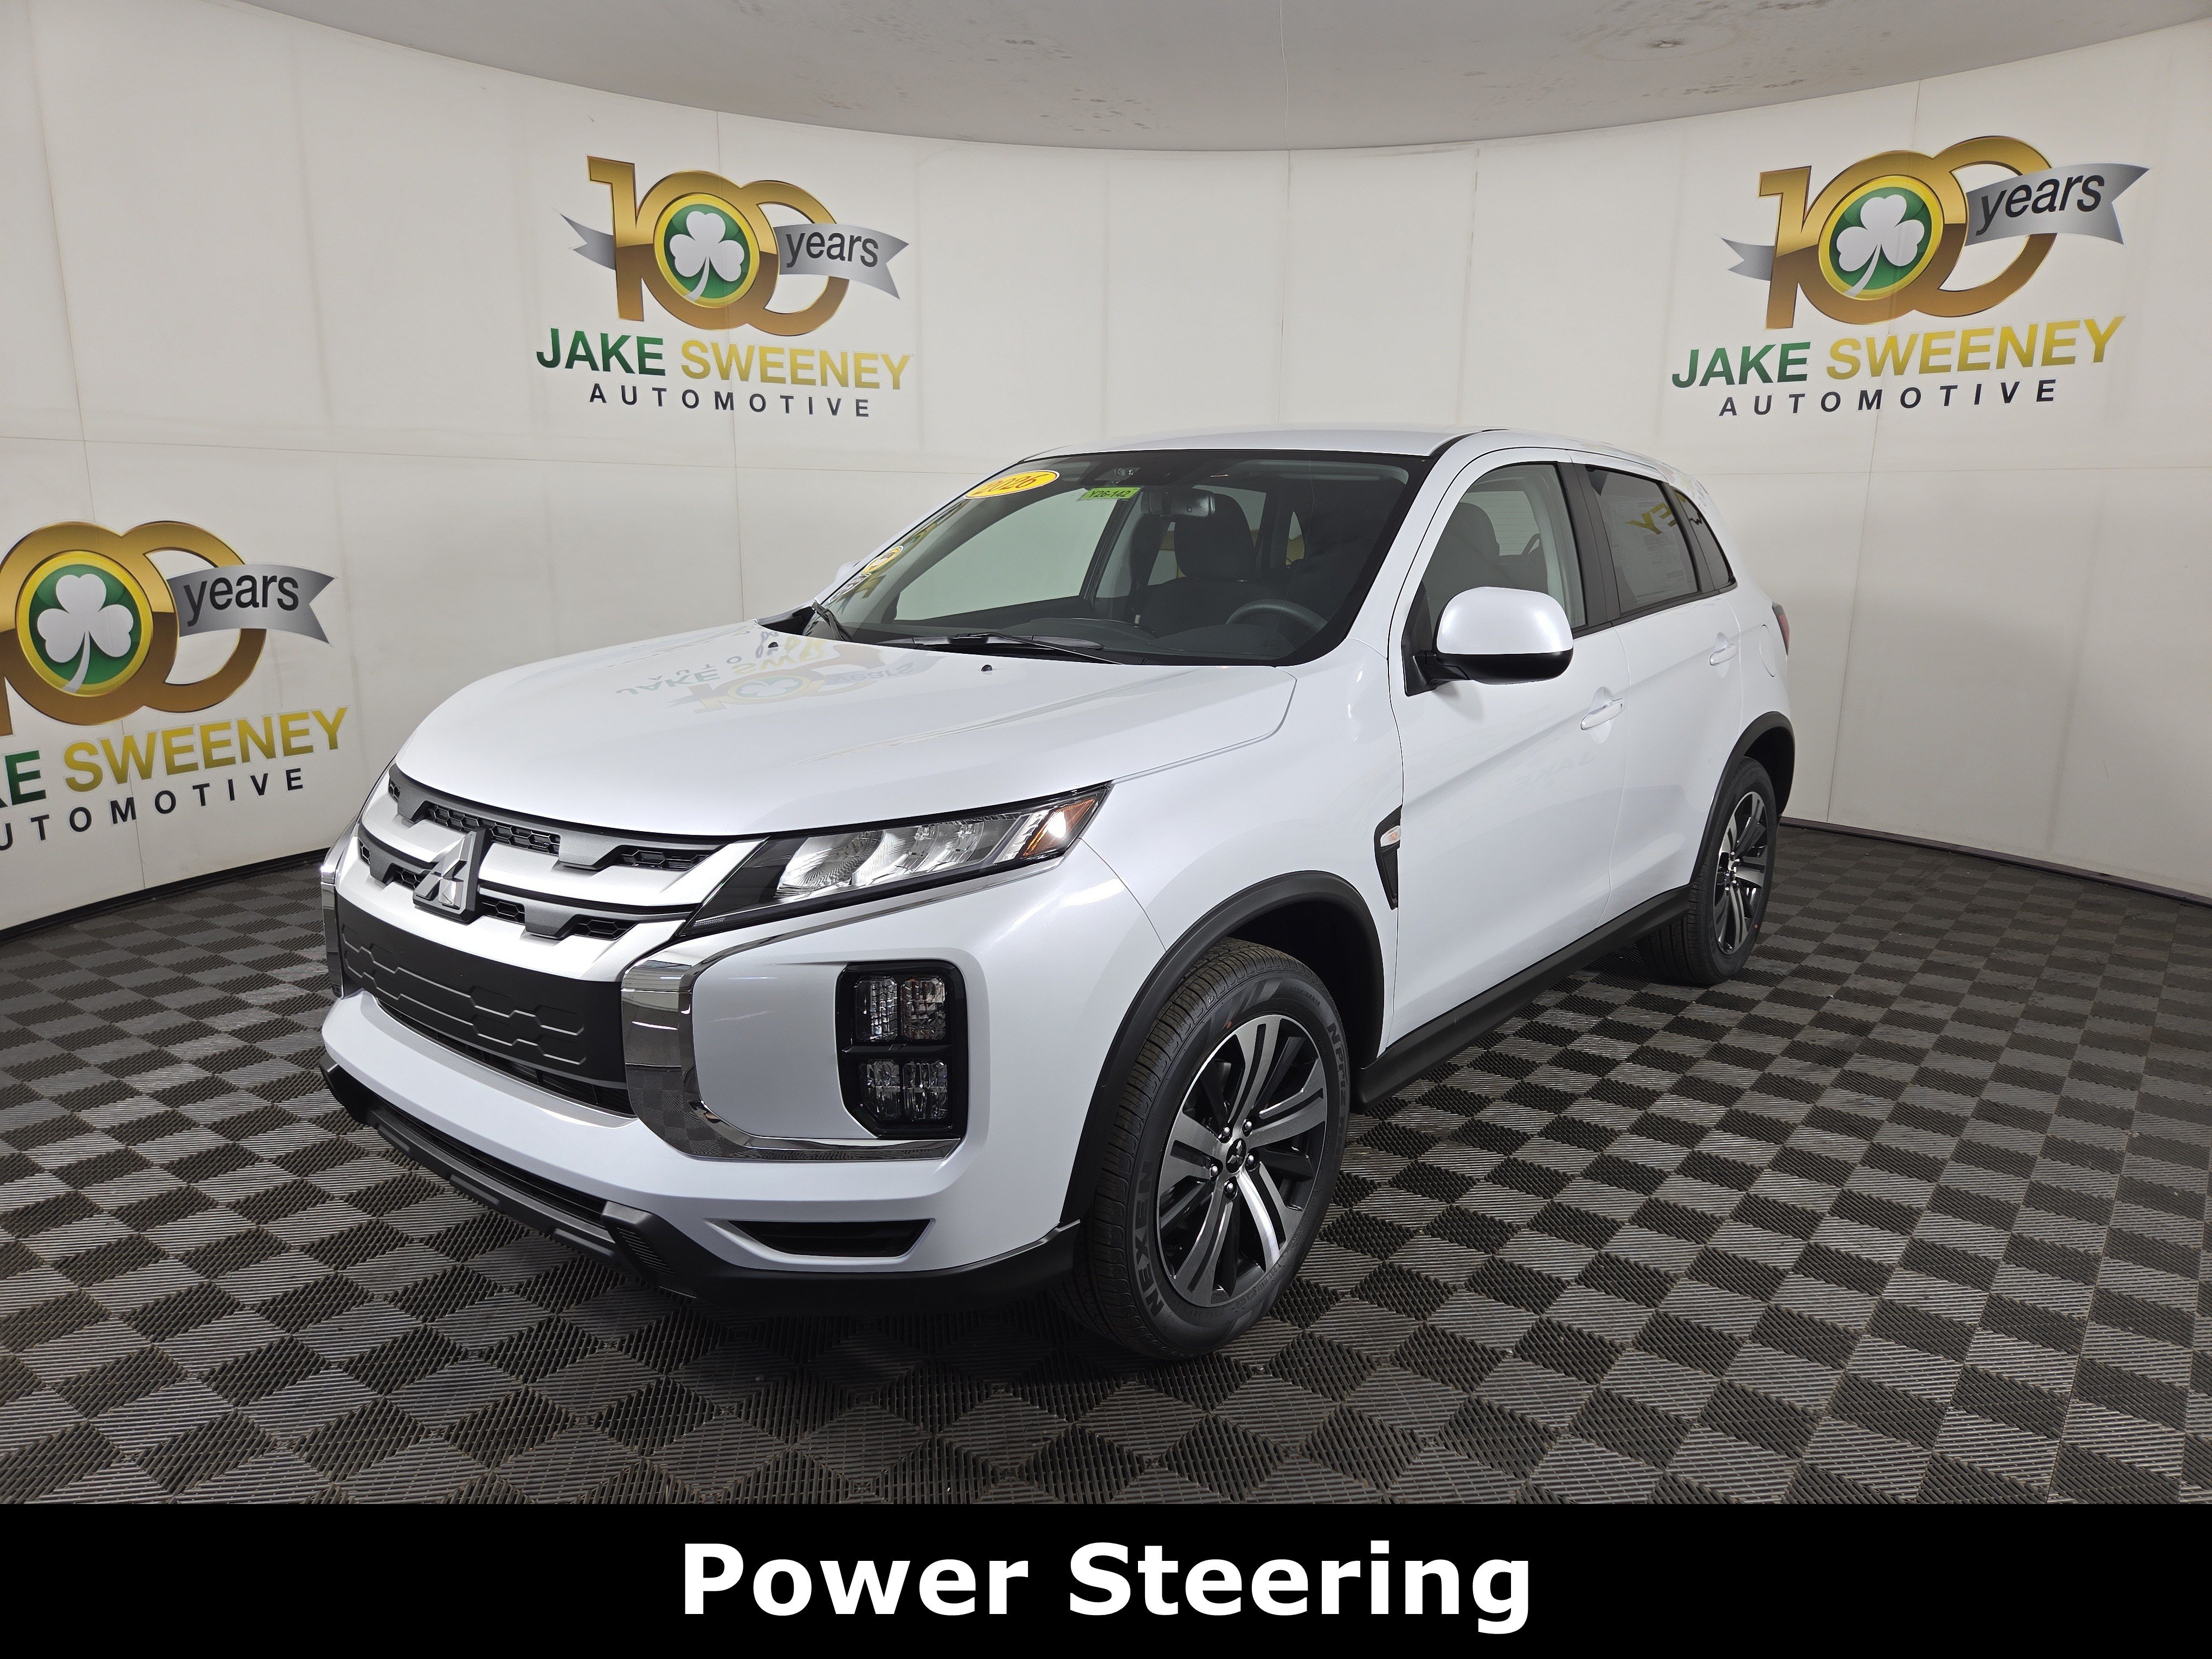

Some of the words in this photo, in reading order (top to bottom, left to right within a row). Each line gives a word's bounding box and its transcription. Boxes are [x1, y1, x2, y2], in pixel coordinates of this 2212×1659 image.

[1759, 136, 2059, 330] 100
[1976, 174, 2105, 237] years
[587, 155, 850, 337] 100
[786, 228, 879, 268] years
[536, 327, 666, 377] JAKE
[681, 339, 911, 390] SWEENEY
[1671, 341, 1811, 389] JAKE
[1826, 316, 2126, 380] SWEENEY
[589, 383, 869, 417] AUTOMOTIVE
[1719, 379, 2056, 417] AUTOMOTIVE
[972, 473, 1050, 496] 2026
[1089, 489, 1131, 498] Y26-142
[183, 574, 299, 627] years
[64, 707, 349, 792] SWEENEY
[0, 768, 304, 851] UTOMOTIVE
[1135, 1160, 1165, 1318] NEXEN
